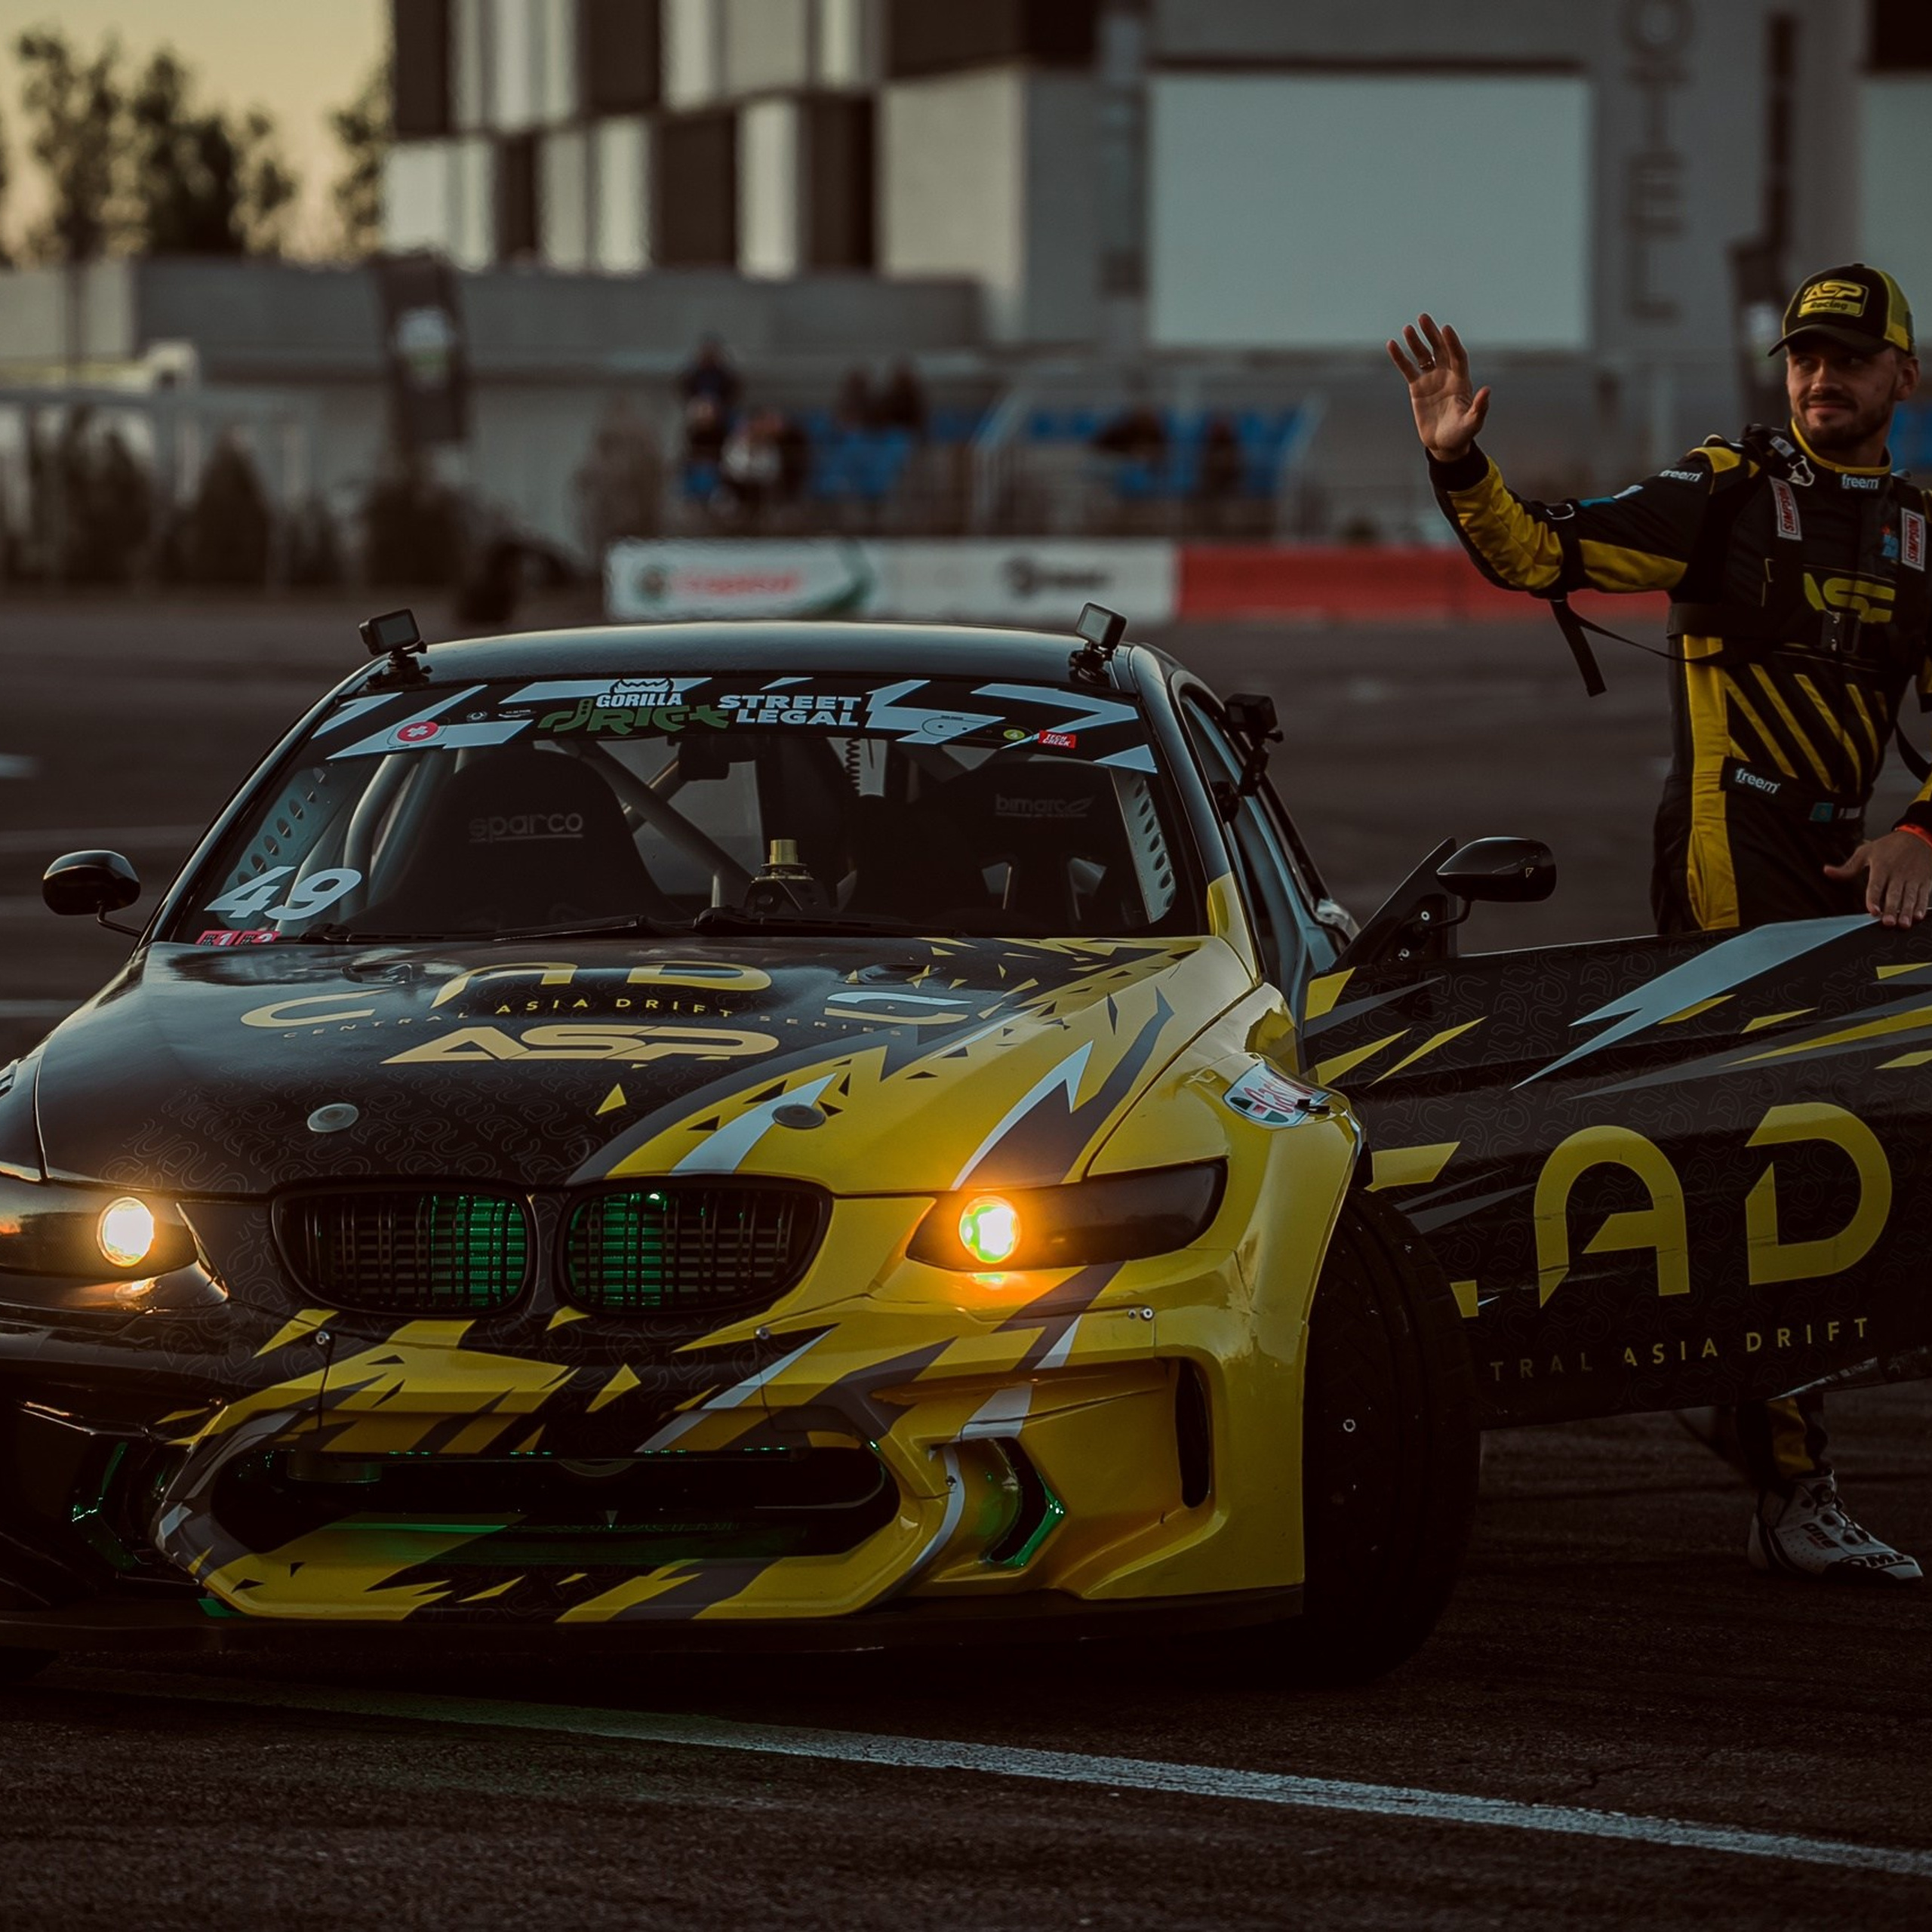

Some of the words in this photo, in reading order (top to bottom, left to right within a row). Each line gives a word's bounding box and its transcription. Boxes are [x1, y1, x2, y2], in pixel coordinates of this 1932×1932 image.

[1804, 281, 1863, 301] ASP
[1841, 473, 1880, 490] freem
[1778, 484, 1795, 533] SIMPSON
[1908, 517, 1919, 562] SIMPSON
[595, 693, 683, 708] GORILLA
[716, 694, 862, 710] STREET
[736, 709, 859, 727] LEGAL
[1736, 768, 1781, 795] freem
[469, 813, 583, 843] sparco
[203, 866, 362, 921] 49
[283, 1011, 469, 1038] CENTRAL
[495, 998, 589, 1015] ASIA
[615, 998, 733, 1017] DRIFT
[380, 1024, 780, 1065] ASP
[1623, 1337, 1718, 1367] ASIA
[1746, 1317, 1868, 1352] DRIFT
